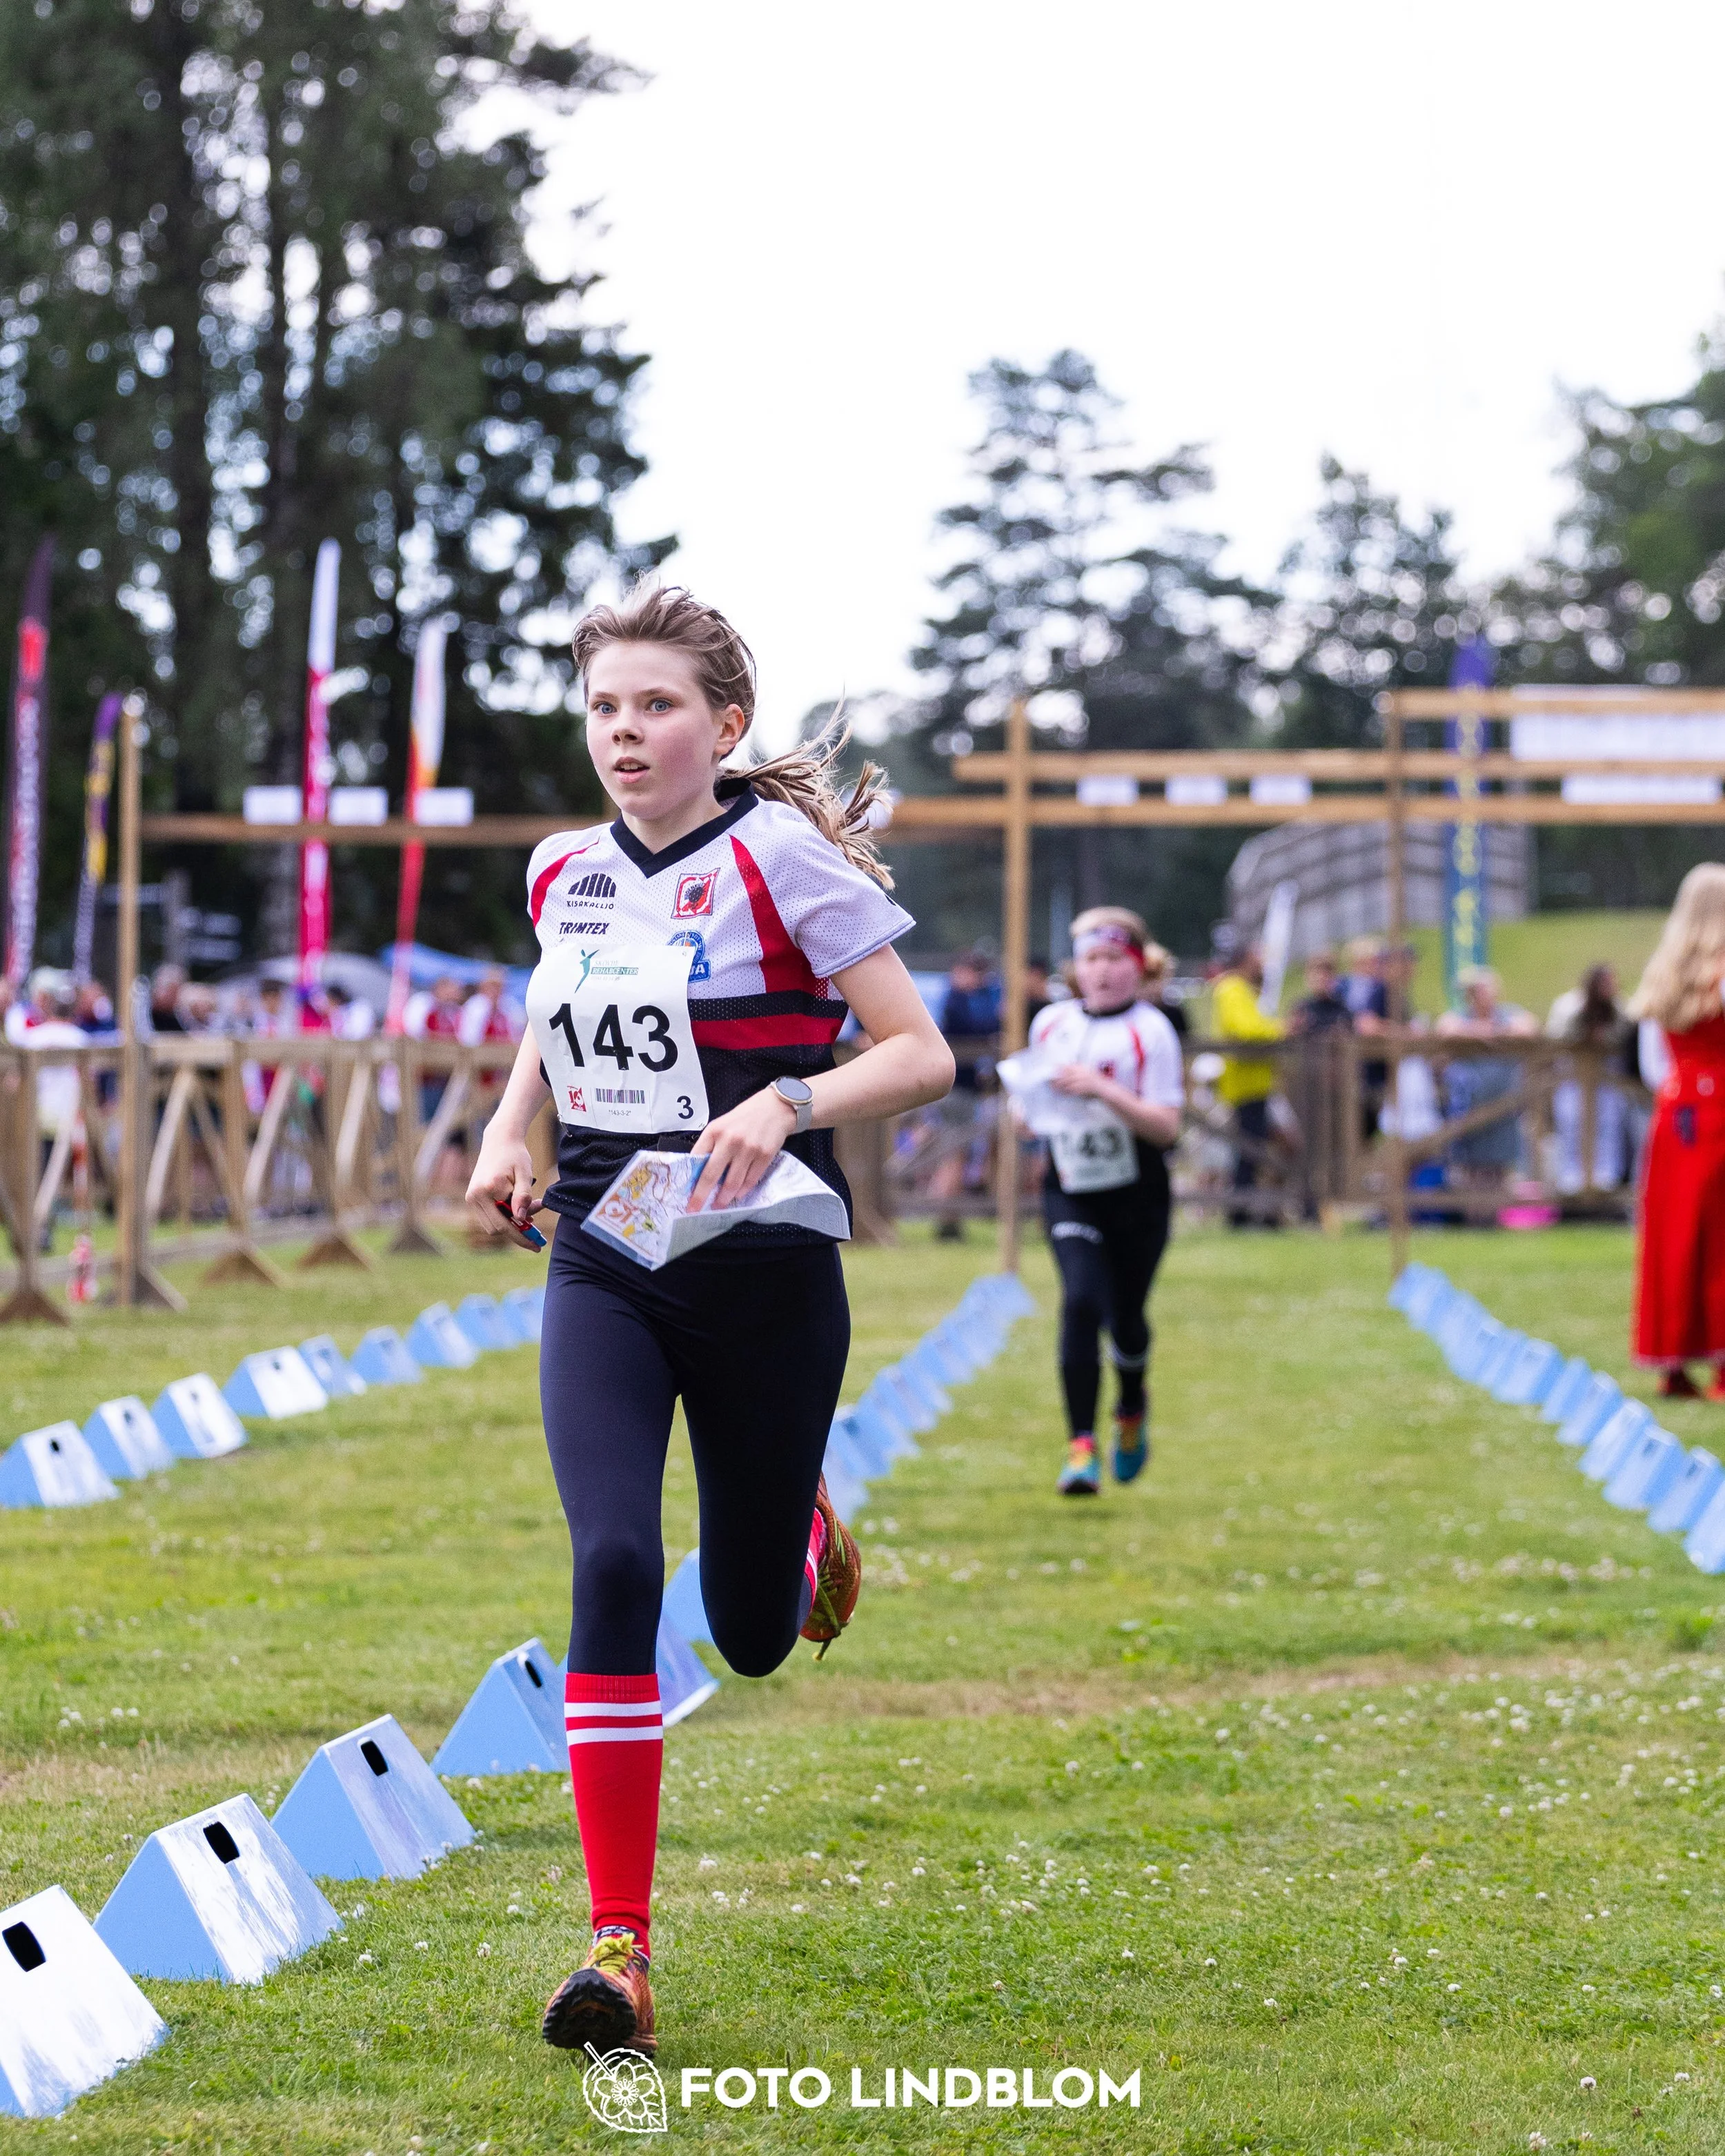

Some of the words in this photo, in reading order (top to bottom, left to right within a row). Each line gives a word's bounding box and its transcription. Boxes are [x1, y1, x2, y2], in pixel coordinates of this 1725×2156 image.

[566, 900, 614, 909] KISAKALLIO
[559, 921, 610, 934] TRIMTEX
[549, 1003, 678, 1072] 143
[676, 1095, 694, 1120] 3
